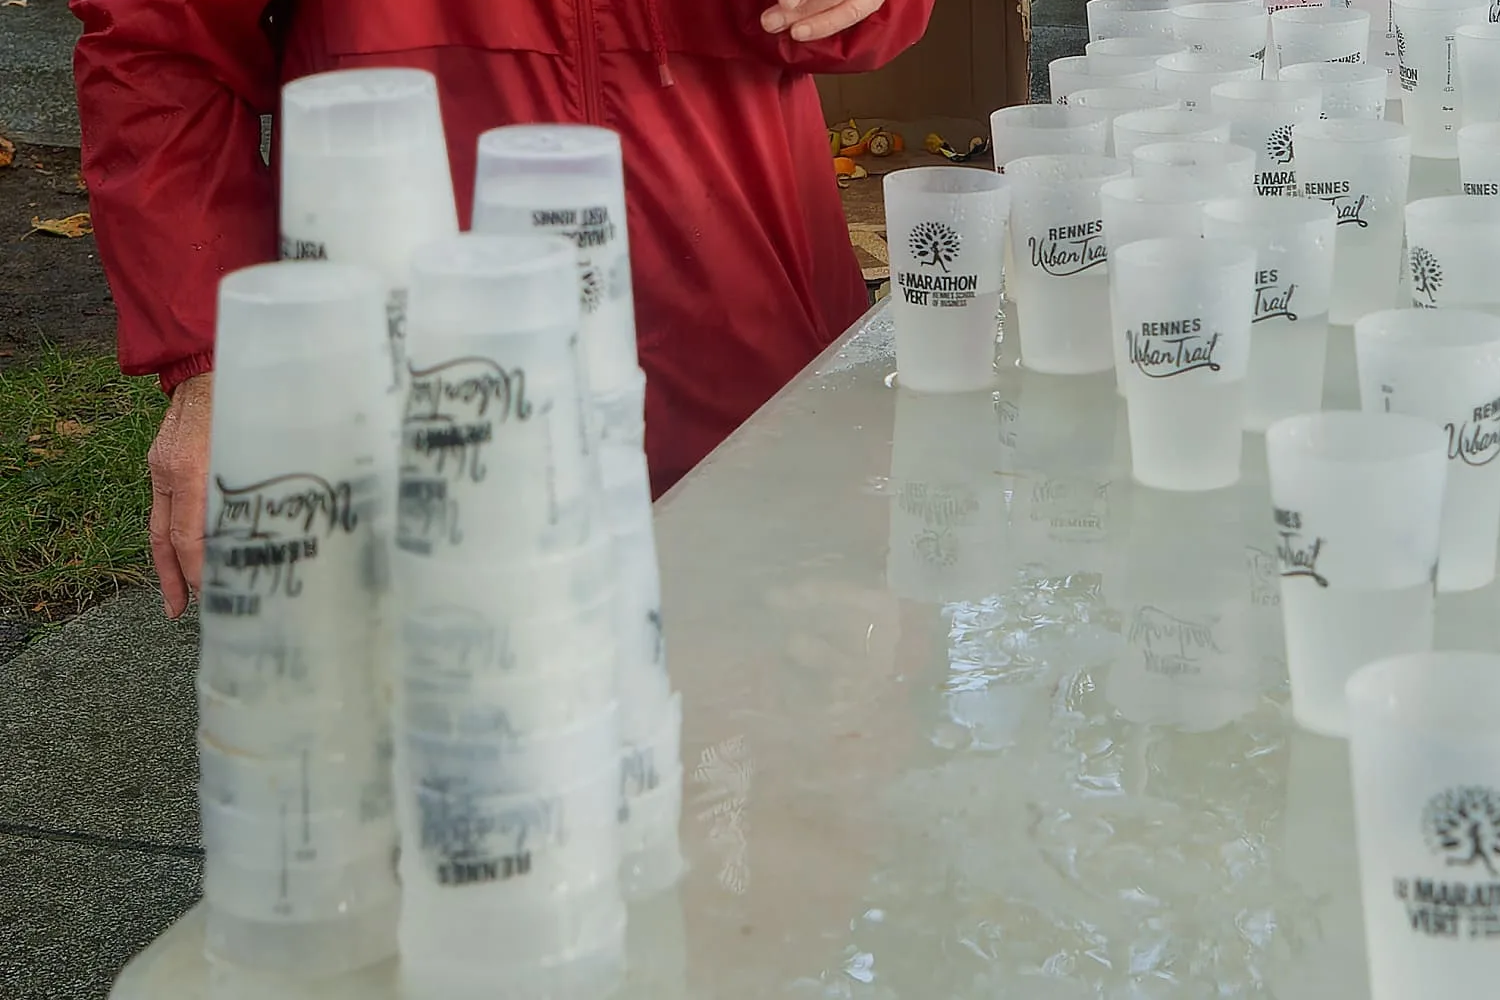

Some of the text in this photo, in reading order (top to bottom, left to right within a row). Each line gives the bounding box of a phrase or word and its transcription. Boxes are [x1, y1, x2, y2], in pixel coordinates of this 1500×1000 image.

[1305, 181, 1350, 195] RENNES
[1048, 219, 1103, 241] RENNES
[906, 272, 977, 291] MARATHON
[903, 287, 931, 306] VERT
[1142, 318, 1202, 337] RENNES
